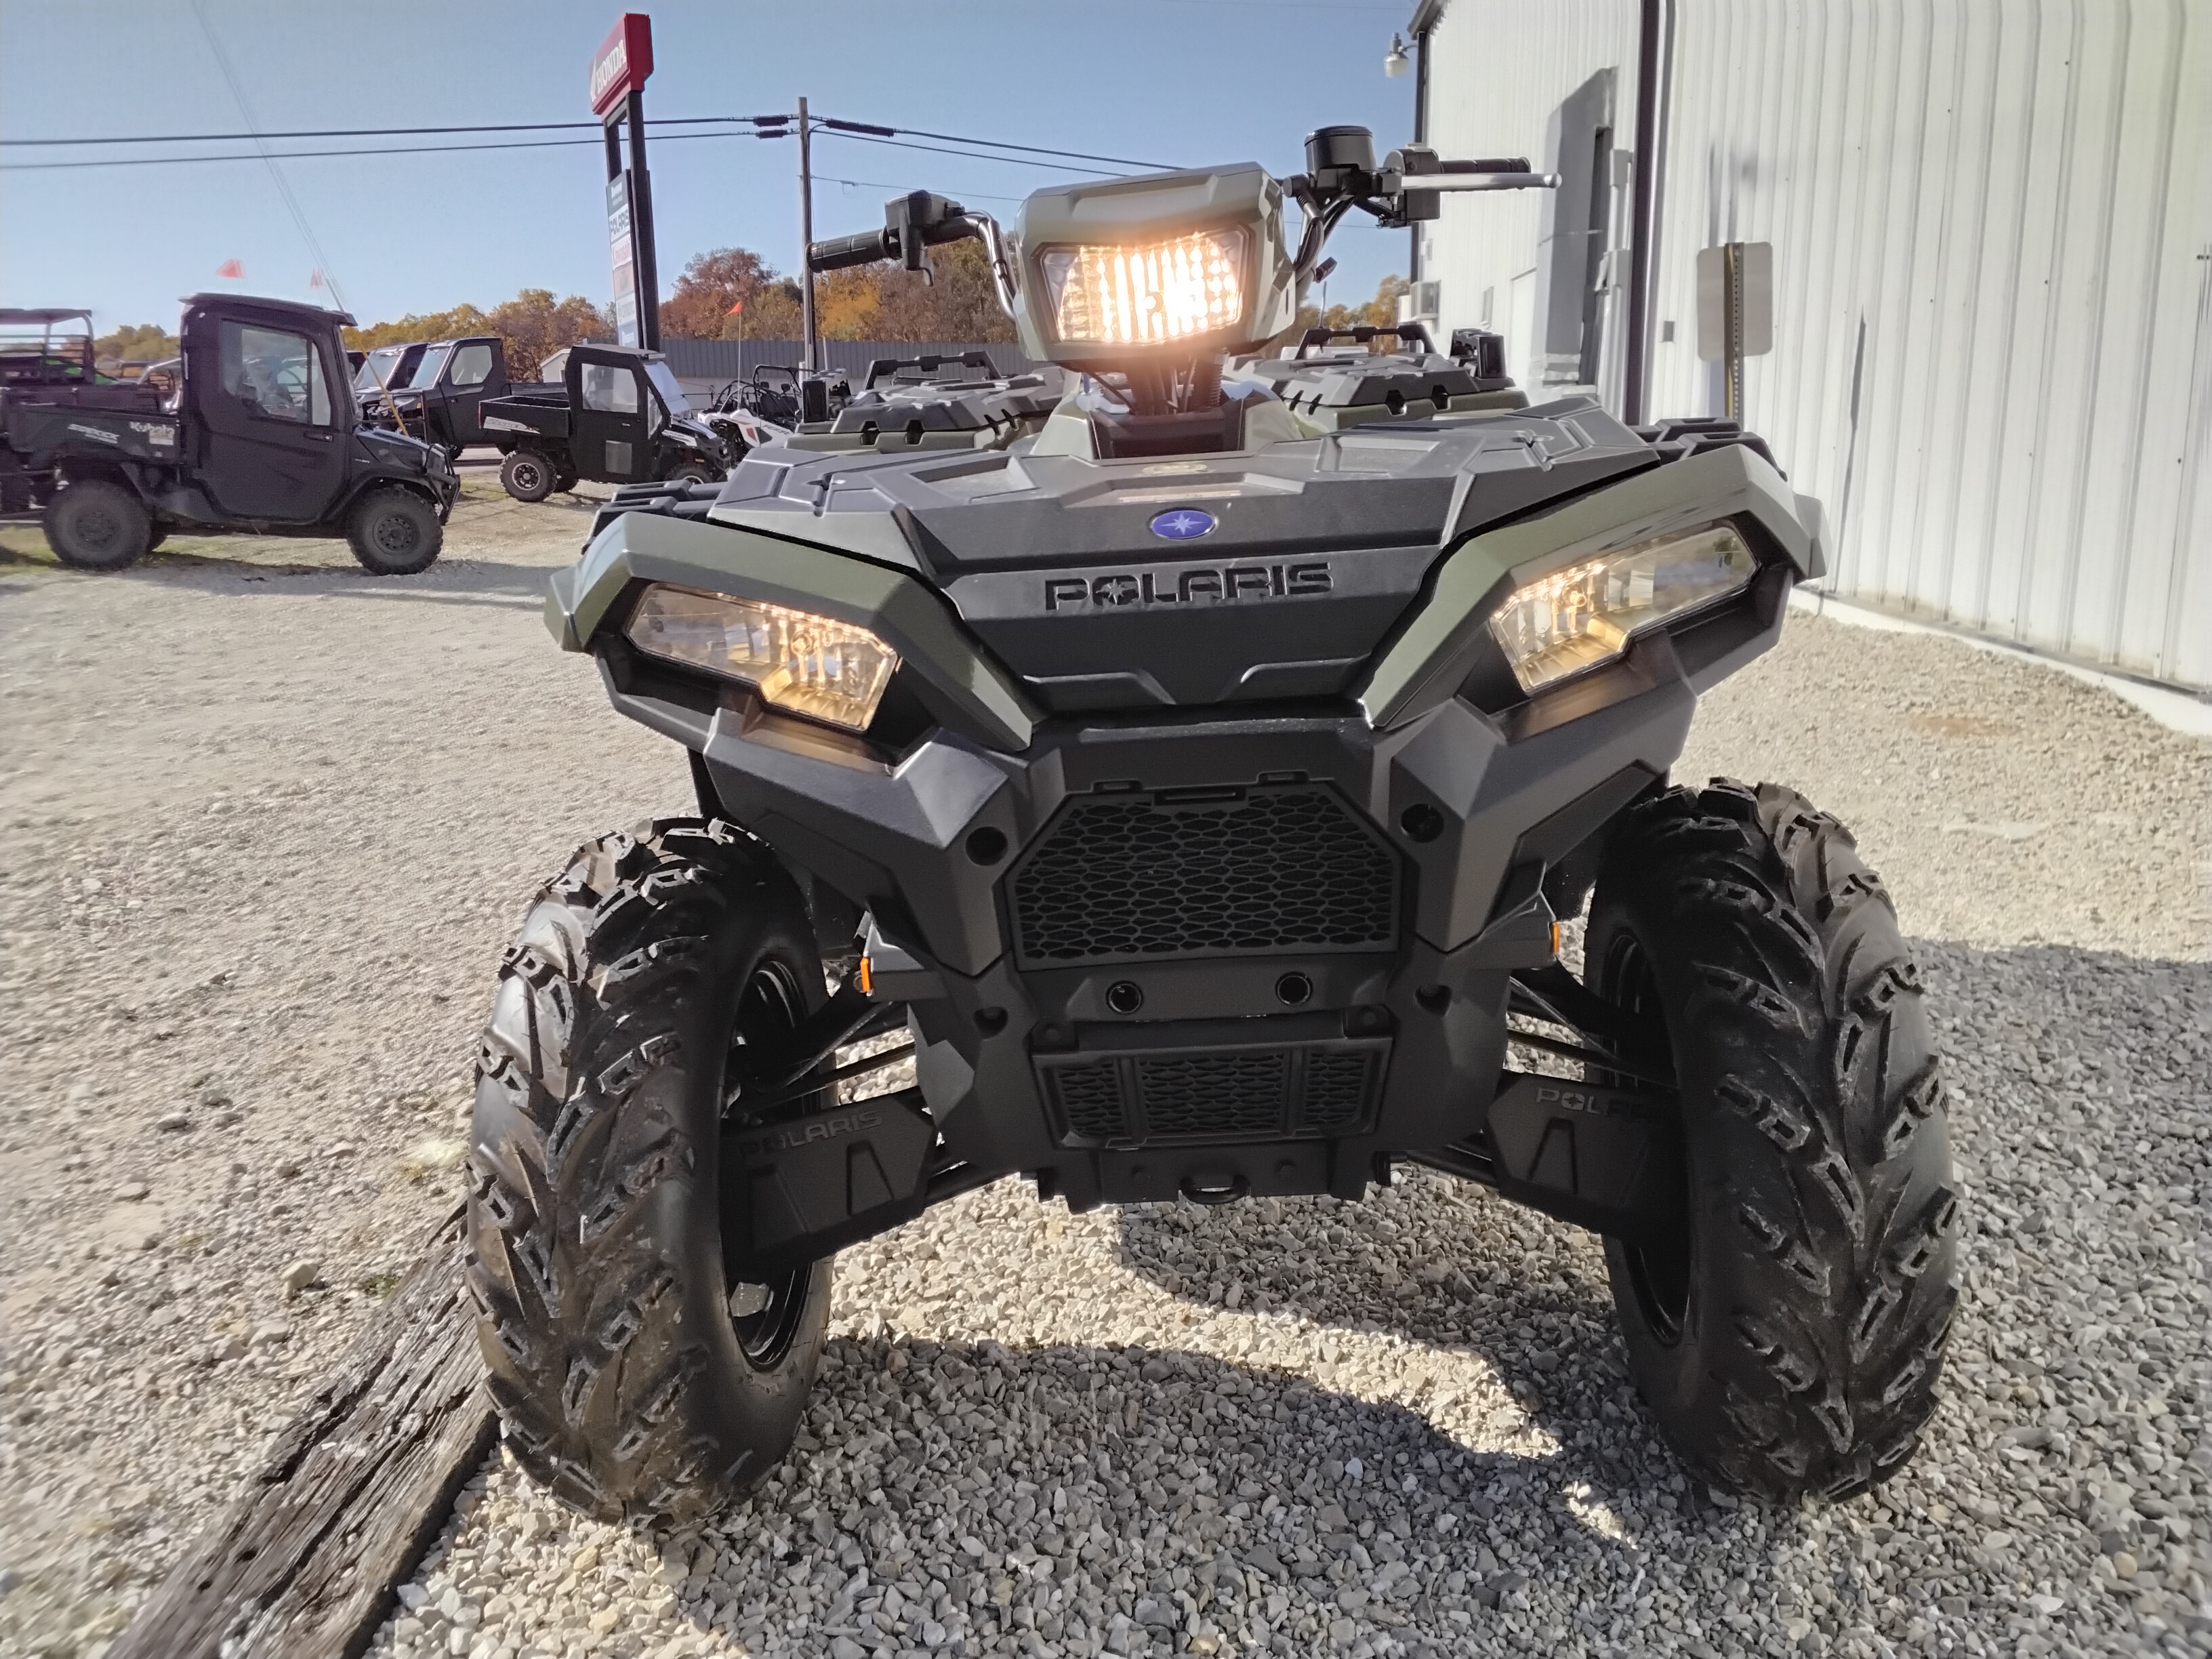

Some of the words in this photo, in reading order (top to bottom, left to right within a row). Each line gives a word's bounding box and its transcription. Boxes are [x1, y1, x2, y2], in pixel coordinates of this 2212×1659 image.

[596, 39, 627, 94] HONDA
[610, 209, 630, 235] POLARIS
[129, 422, 175, 434] Kubota
[762, 424, 790, 435] RZR
[1045, 562, 1334, 611] POLARIS
